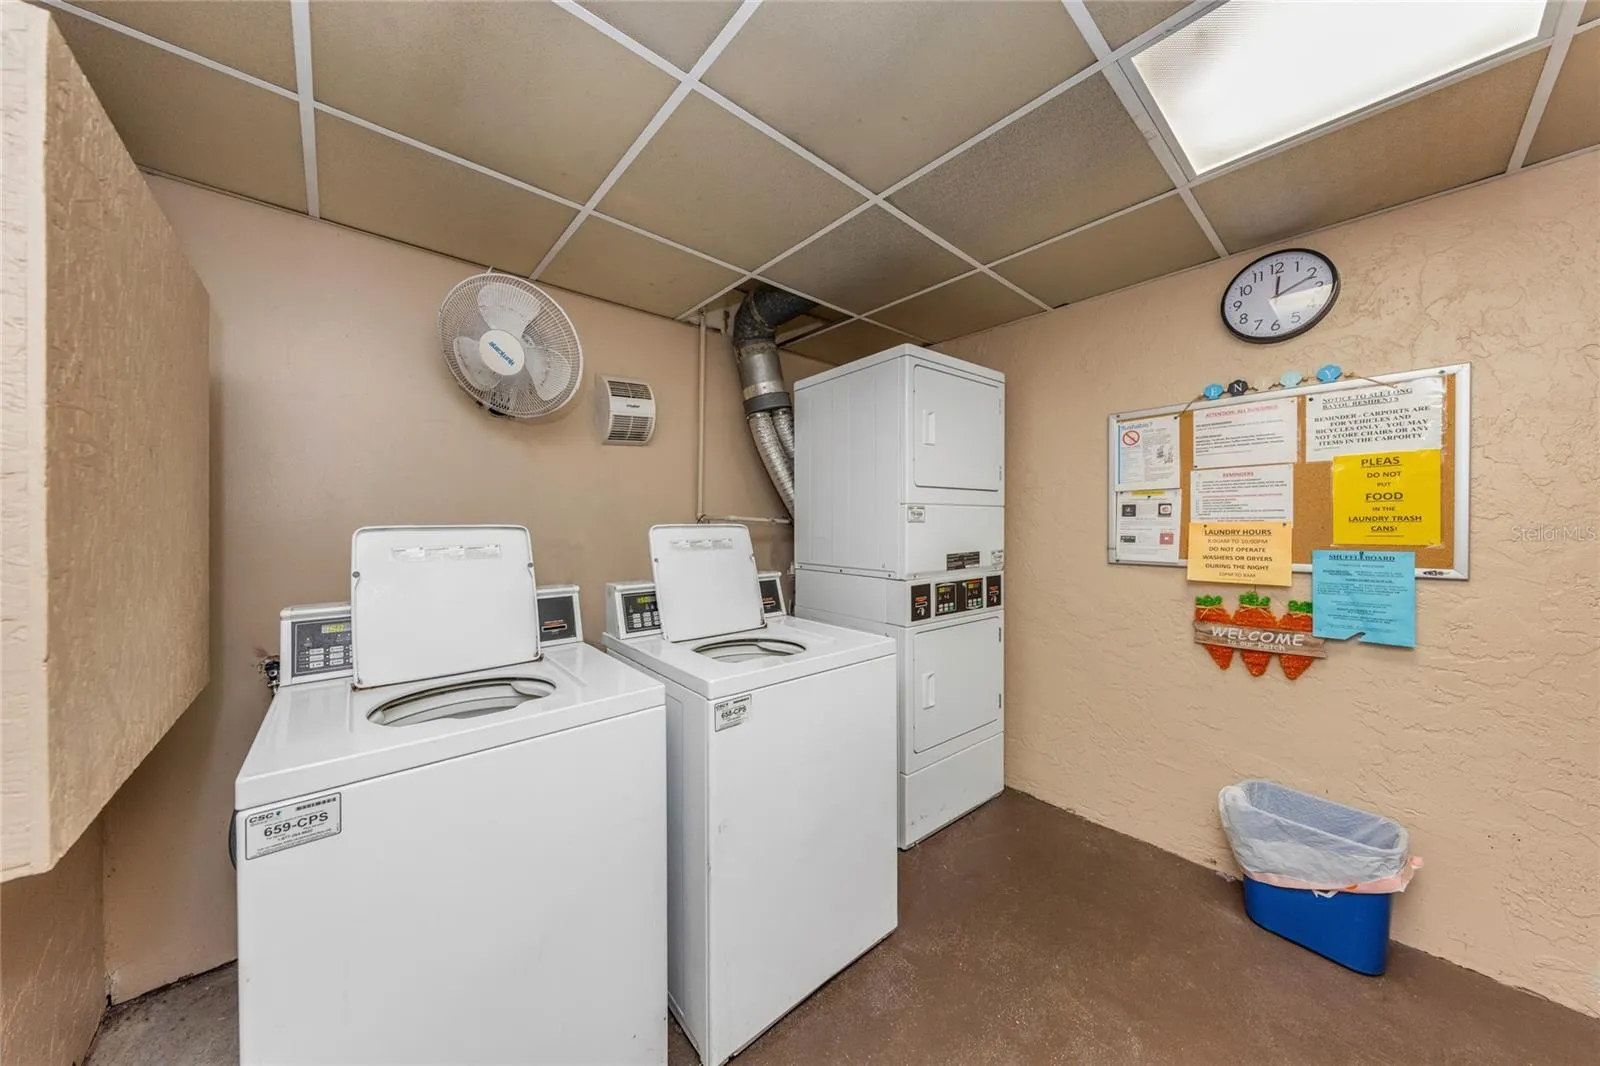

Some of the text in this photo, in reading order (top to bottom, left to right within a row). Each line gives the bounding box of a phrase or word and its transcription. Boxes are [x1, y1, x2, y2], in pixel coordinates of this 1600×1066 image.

[1270, 262, 1284, 275] 12
[1307, 267, 1317, 279] 2
[1253, 271, 1263, 283] 11
[1240, 284, 1252, 296] 10
[1233, 300, 1242, 311] 9
[1240, 313, 1248, 324] 8
[1291, 312, 1301, 323] 5
[1254, 319, 1263, 331] 7
[1271, 320, 1280, 331] 6
[1322, 395, 1354, 403] NOTICE
[1352, 397, 1399, 407] RESIDENTS
[1314, 414, 1357, 422] REMINDER
[1363, 408, 1409, 418] CARPORTS
[1348, 416, 1391, 426] VEHICLES
[1316, 426, 1355, 434] BICYCLES
[1332, 430, 1360, 438] STORE
[1361, 428, 1394, 437] CHAIRS
[1319, 438, 1344, 446] ITEMS
[1365, 492, 1403, 501] FOOD
[1211, 625, 1305, 646] WELCOME
[1258, 642, 1285, 651] Patch
[249, 812, 274, 823] CSC
[264, 812, 328, 837] 659-CPS
